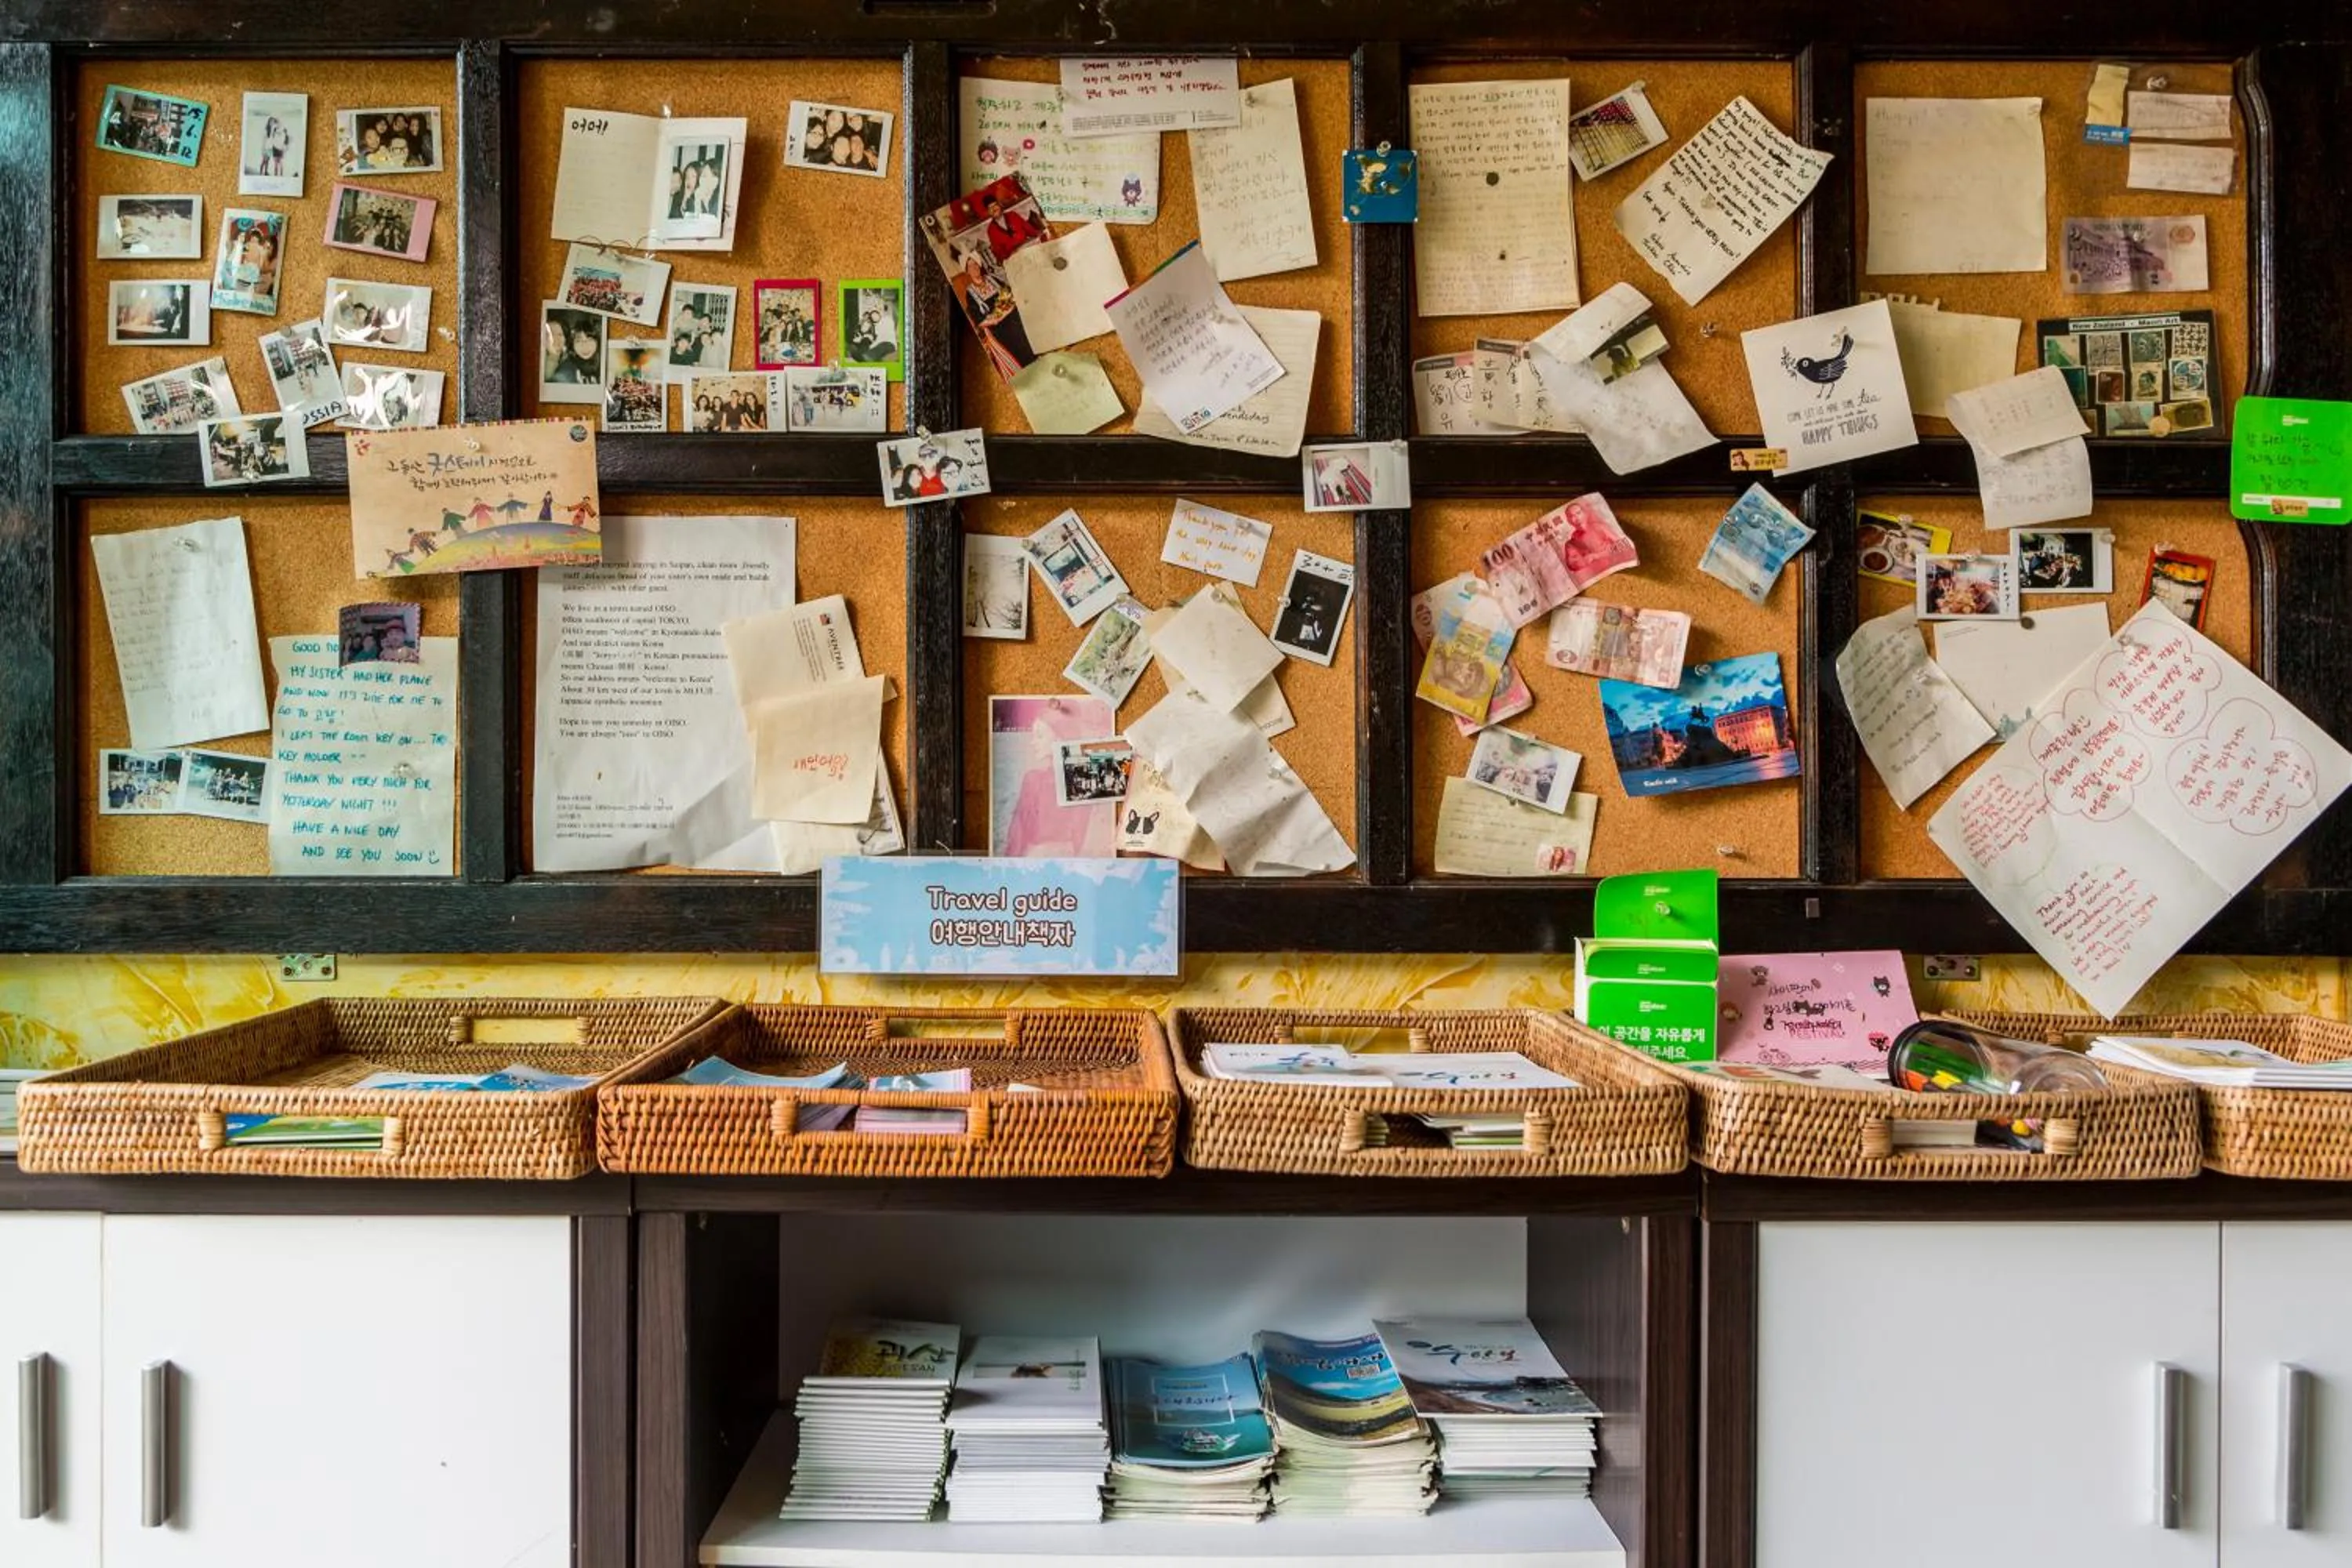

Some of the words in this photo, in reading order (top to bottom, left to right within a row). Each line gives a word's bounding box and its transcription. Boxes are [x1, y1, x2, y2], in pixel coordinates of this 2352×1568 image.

[1802, 424, 1833, 445] HAPPY
[1837, 414, 1878, 437] THINGS
[427, 452, 485, 477] 굿스테이
[1483, 543, 1514, 568] 100
[1519, 598, 1537, 615] 100
[292, 641, 321, 653] GOOD
[290, 666, 304, 678] MY
[292, 821, 325, 835] HAVE
[330, 824, 339, 835] A
[378, 826, 401, 838] DAY
[301, 845, 325, 858] AND
[926, 885, 1007, 911] Travel
[1012, 887, 1078, 918] guide
[2036, 896, 2063, 917] Thank
[2064, 881, 2079, 908] you
[930, 919, 1076, 947] 여행안내책자
[1613, 1026, 1652, 1043] 공간을
[1655, 1027, 1705, 1044] 자유롭게
[878, 1340, 956, 1363] 괴산
